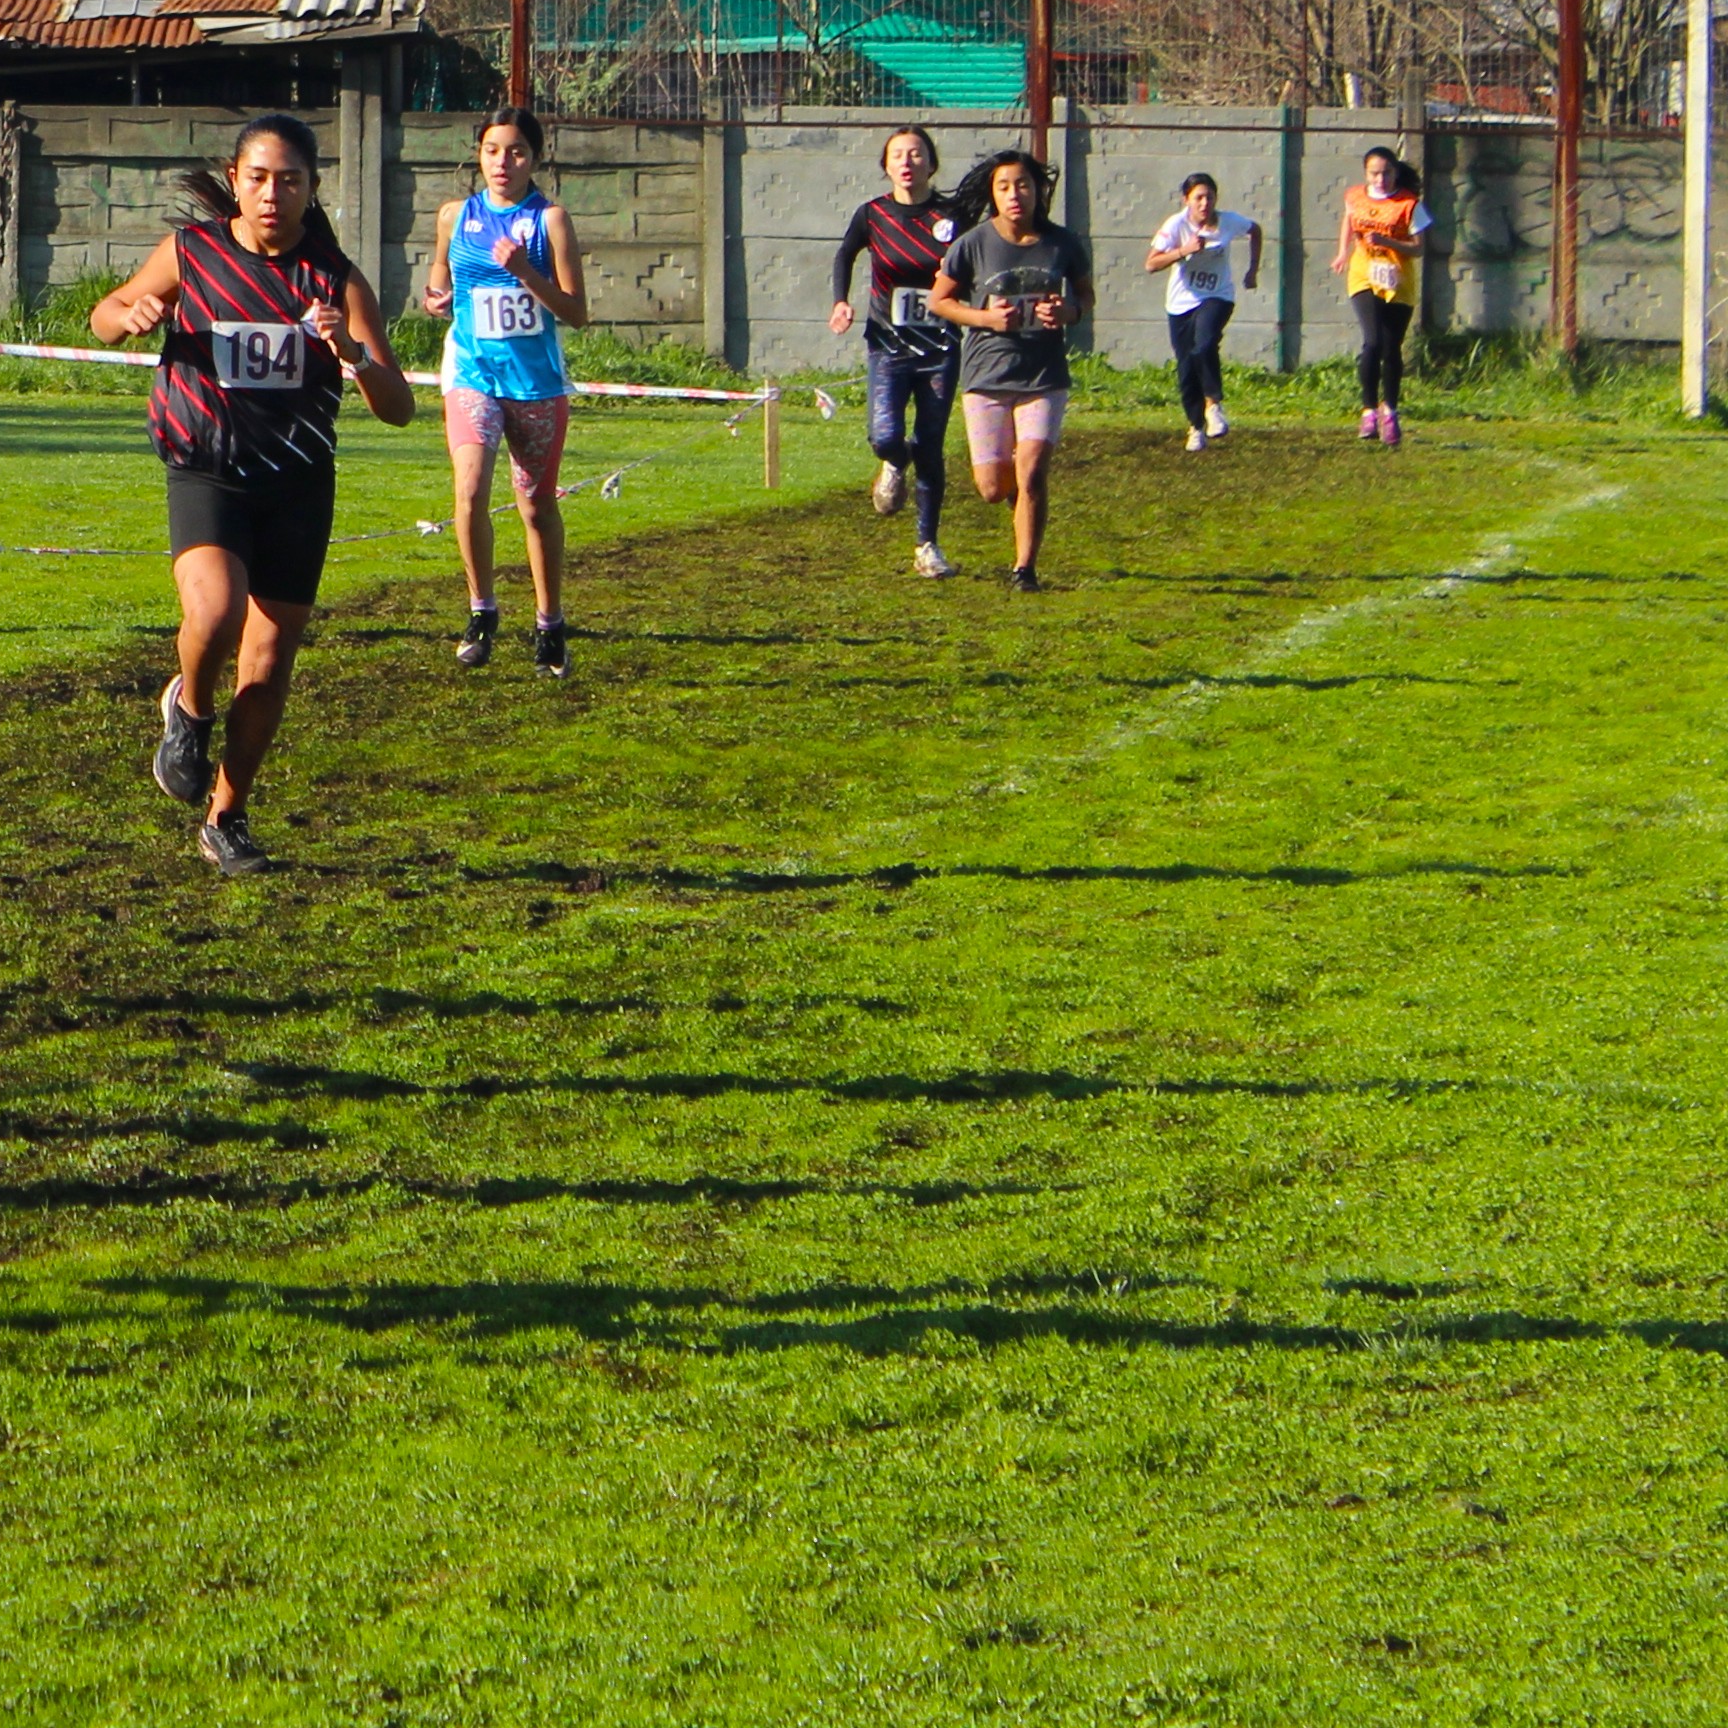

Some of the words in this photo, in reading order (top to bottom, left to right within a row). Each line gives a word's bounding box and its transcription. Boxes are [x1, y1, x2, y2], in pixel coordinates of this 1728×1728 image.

[1189, 271, 1218, 291] 199
[483, 293, 537, 332] 163
[901, 292, 940, 322] 15
[225, 331, 298, 381] 194
